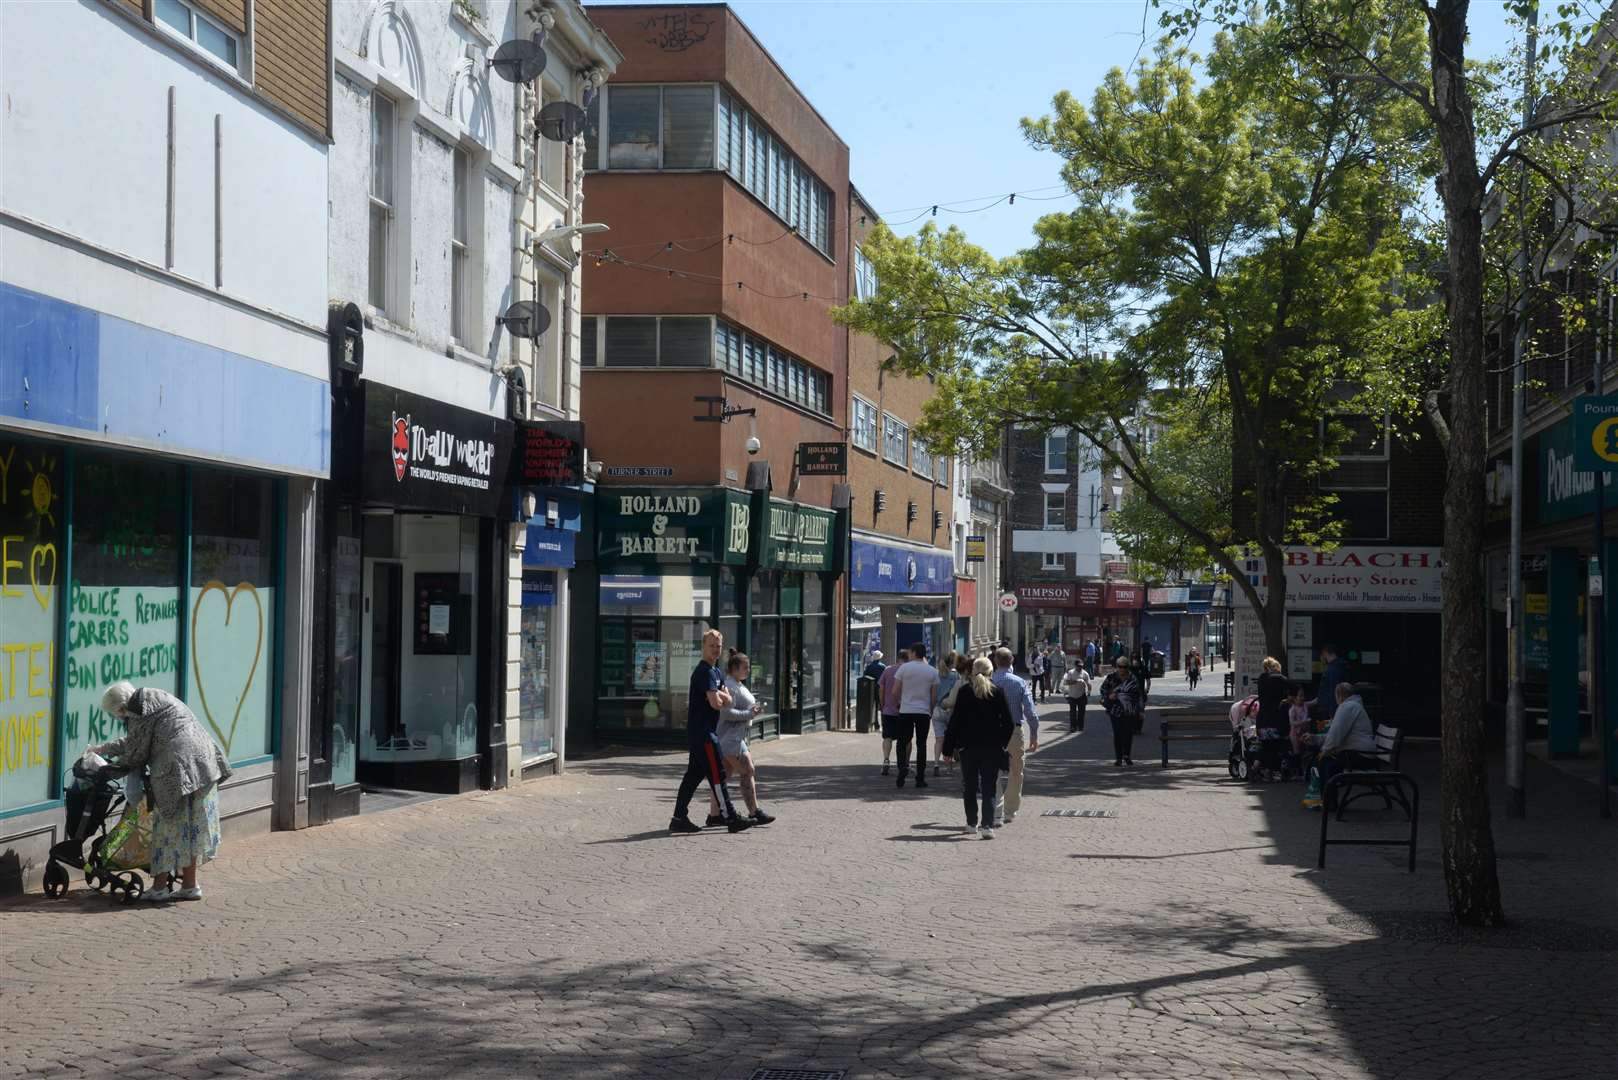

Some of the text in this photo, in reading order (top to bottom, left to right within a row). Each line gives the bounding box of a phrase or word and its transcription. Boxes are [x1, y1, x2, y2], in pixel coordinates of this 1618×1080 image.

[807, 447, 838, 455] HOLLAND
[410, 466, 420, 478] THE
[419, 469, 440, 481] WORLD'S
[440, 471, 457, 484] PREMIER
[610, 468, 671, 476] TURNER STREET
[806, 463, 839, 471] BARRETT
[620, 495, 701, 515] HOLLAND
[652, 514, 668, 535] &
[621, 537, 699, 556] BARRETT
[1285, 551, 1431, 568] BEACH
[1299, 573, 1362, 588] Variety
[1368, 573, 1418, 586] Store
[71, 580, 120, 617] POLICE
[1020, 587, 1071, 598] TIMPSON
[1336, 591, 1358, 601] Mobile
[68, 619, 129, 652] CARERS
[68, 656, 97, 690] BIN
